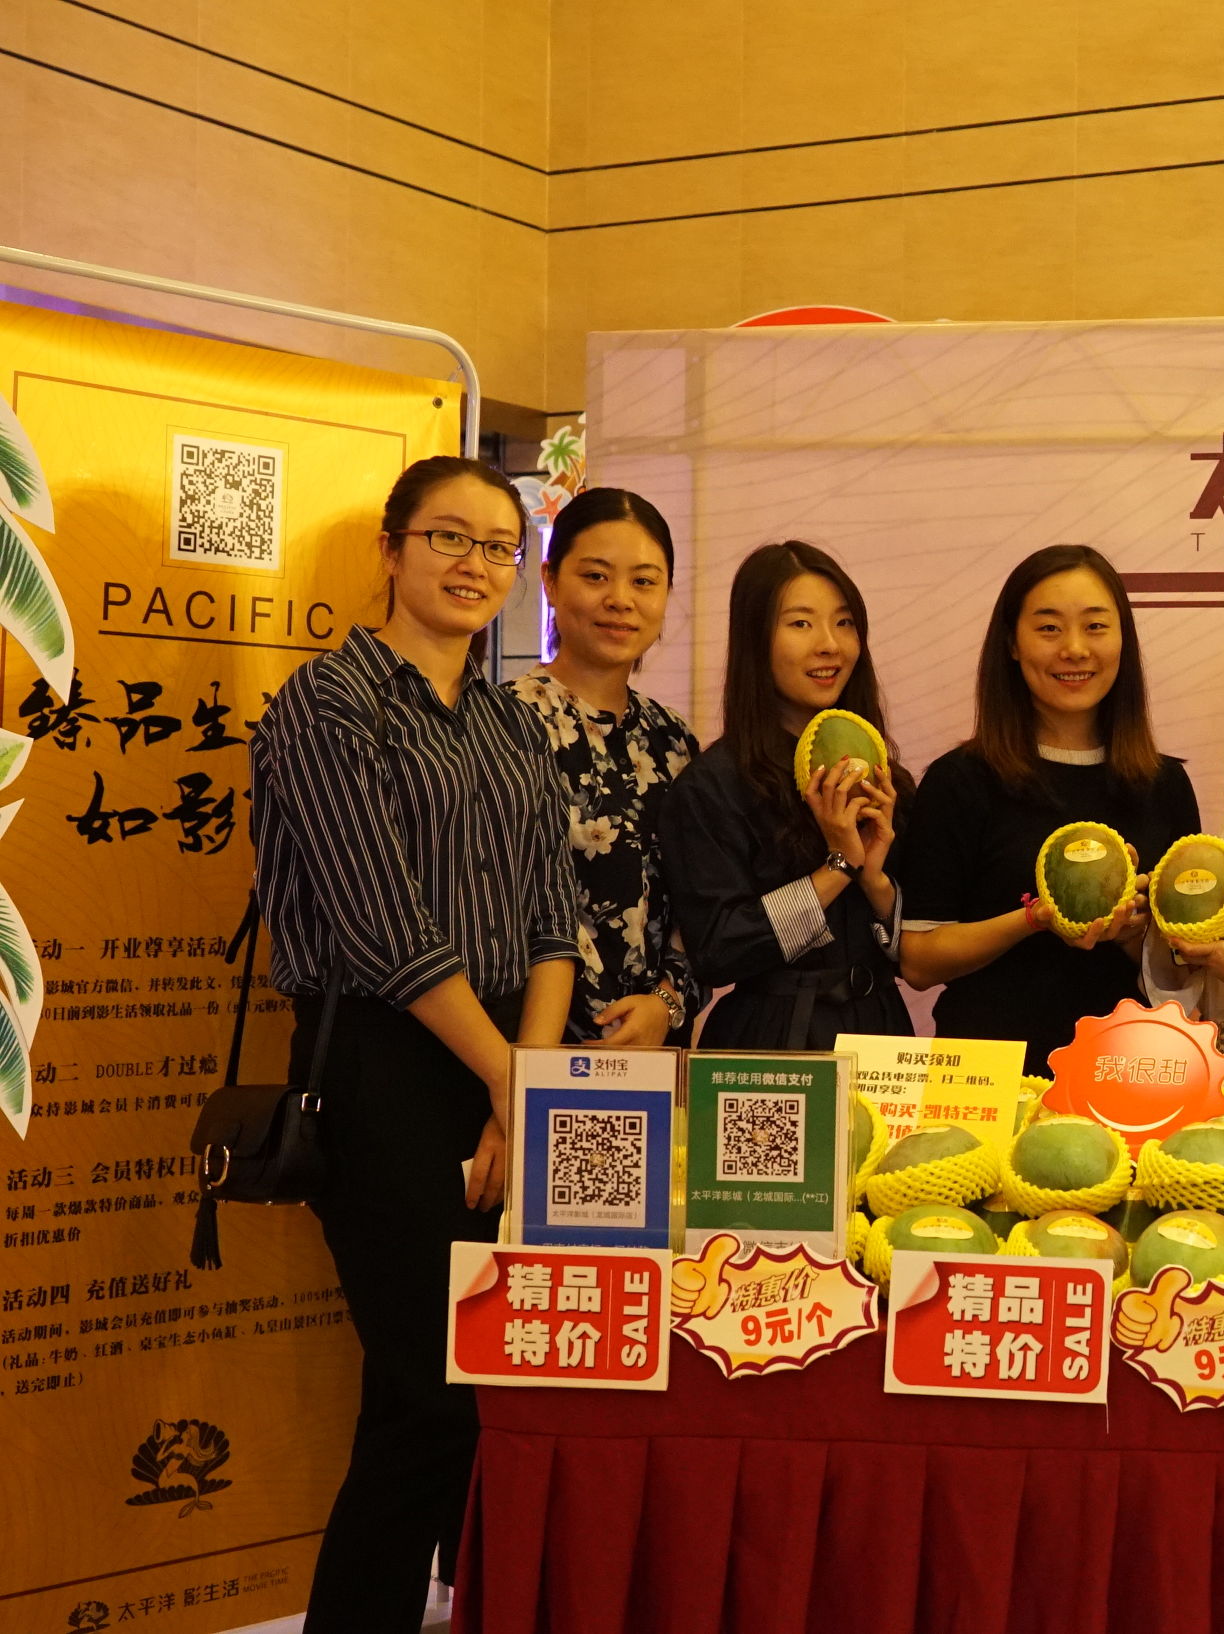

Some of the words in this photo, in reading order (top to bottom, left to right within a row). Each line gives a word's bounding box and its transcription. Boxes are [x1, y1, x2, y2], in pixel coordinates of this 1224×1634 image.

[102, 581, 334, 641] PACIFIC
[18, 667, 273, 755] 臻品生
[66, 771, 254, 855] 如影
[99, 935, 228, 960] 开业尊享活动
[30, 1062, 79, 1085] 动二
[593, 1058, 629, 1072] 支付宝
[711, 1071, 814, 1087] 推荐使用微信支付
[896, 1051, 962, 1068] 购买须知
[1094, 1054, 1189, 1086] 我很甜
[872, 1102, 998, 1122] 购买-凯特芒果
[7, 1164, 76, 1192] 活动三
[90, 1155, 197, 1184] 会员特权日
[3, 1226, 81, 1249] 折扣优惠价
[1, 1283, 72, 1312] 活动四
[86, 1269, 193, 1303] 充值送好礼
[507, 1263, 602, 1313] 精品
[730, 1263, 820, 1313] 特惠价
[947, 1273, 1044, 1326] 精品
[621, 1271, 650, 1369] SALE
[740, 1301, 834, 1347] 9元/个
[1062, 1282, 1094, 1381] SALE
[504, 1318, 602, 1369] 特价
[944, 1330, 1045, 1381] 特价
[117, 1591, 177, 1623] 太平洋
[183, 1577, 241, 1608] 影生活
